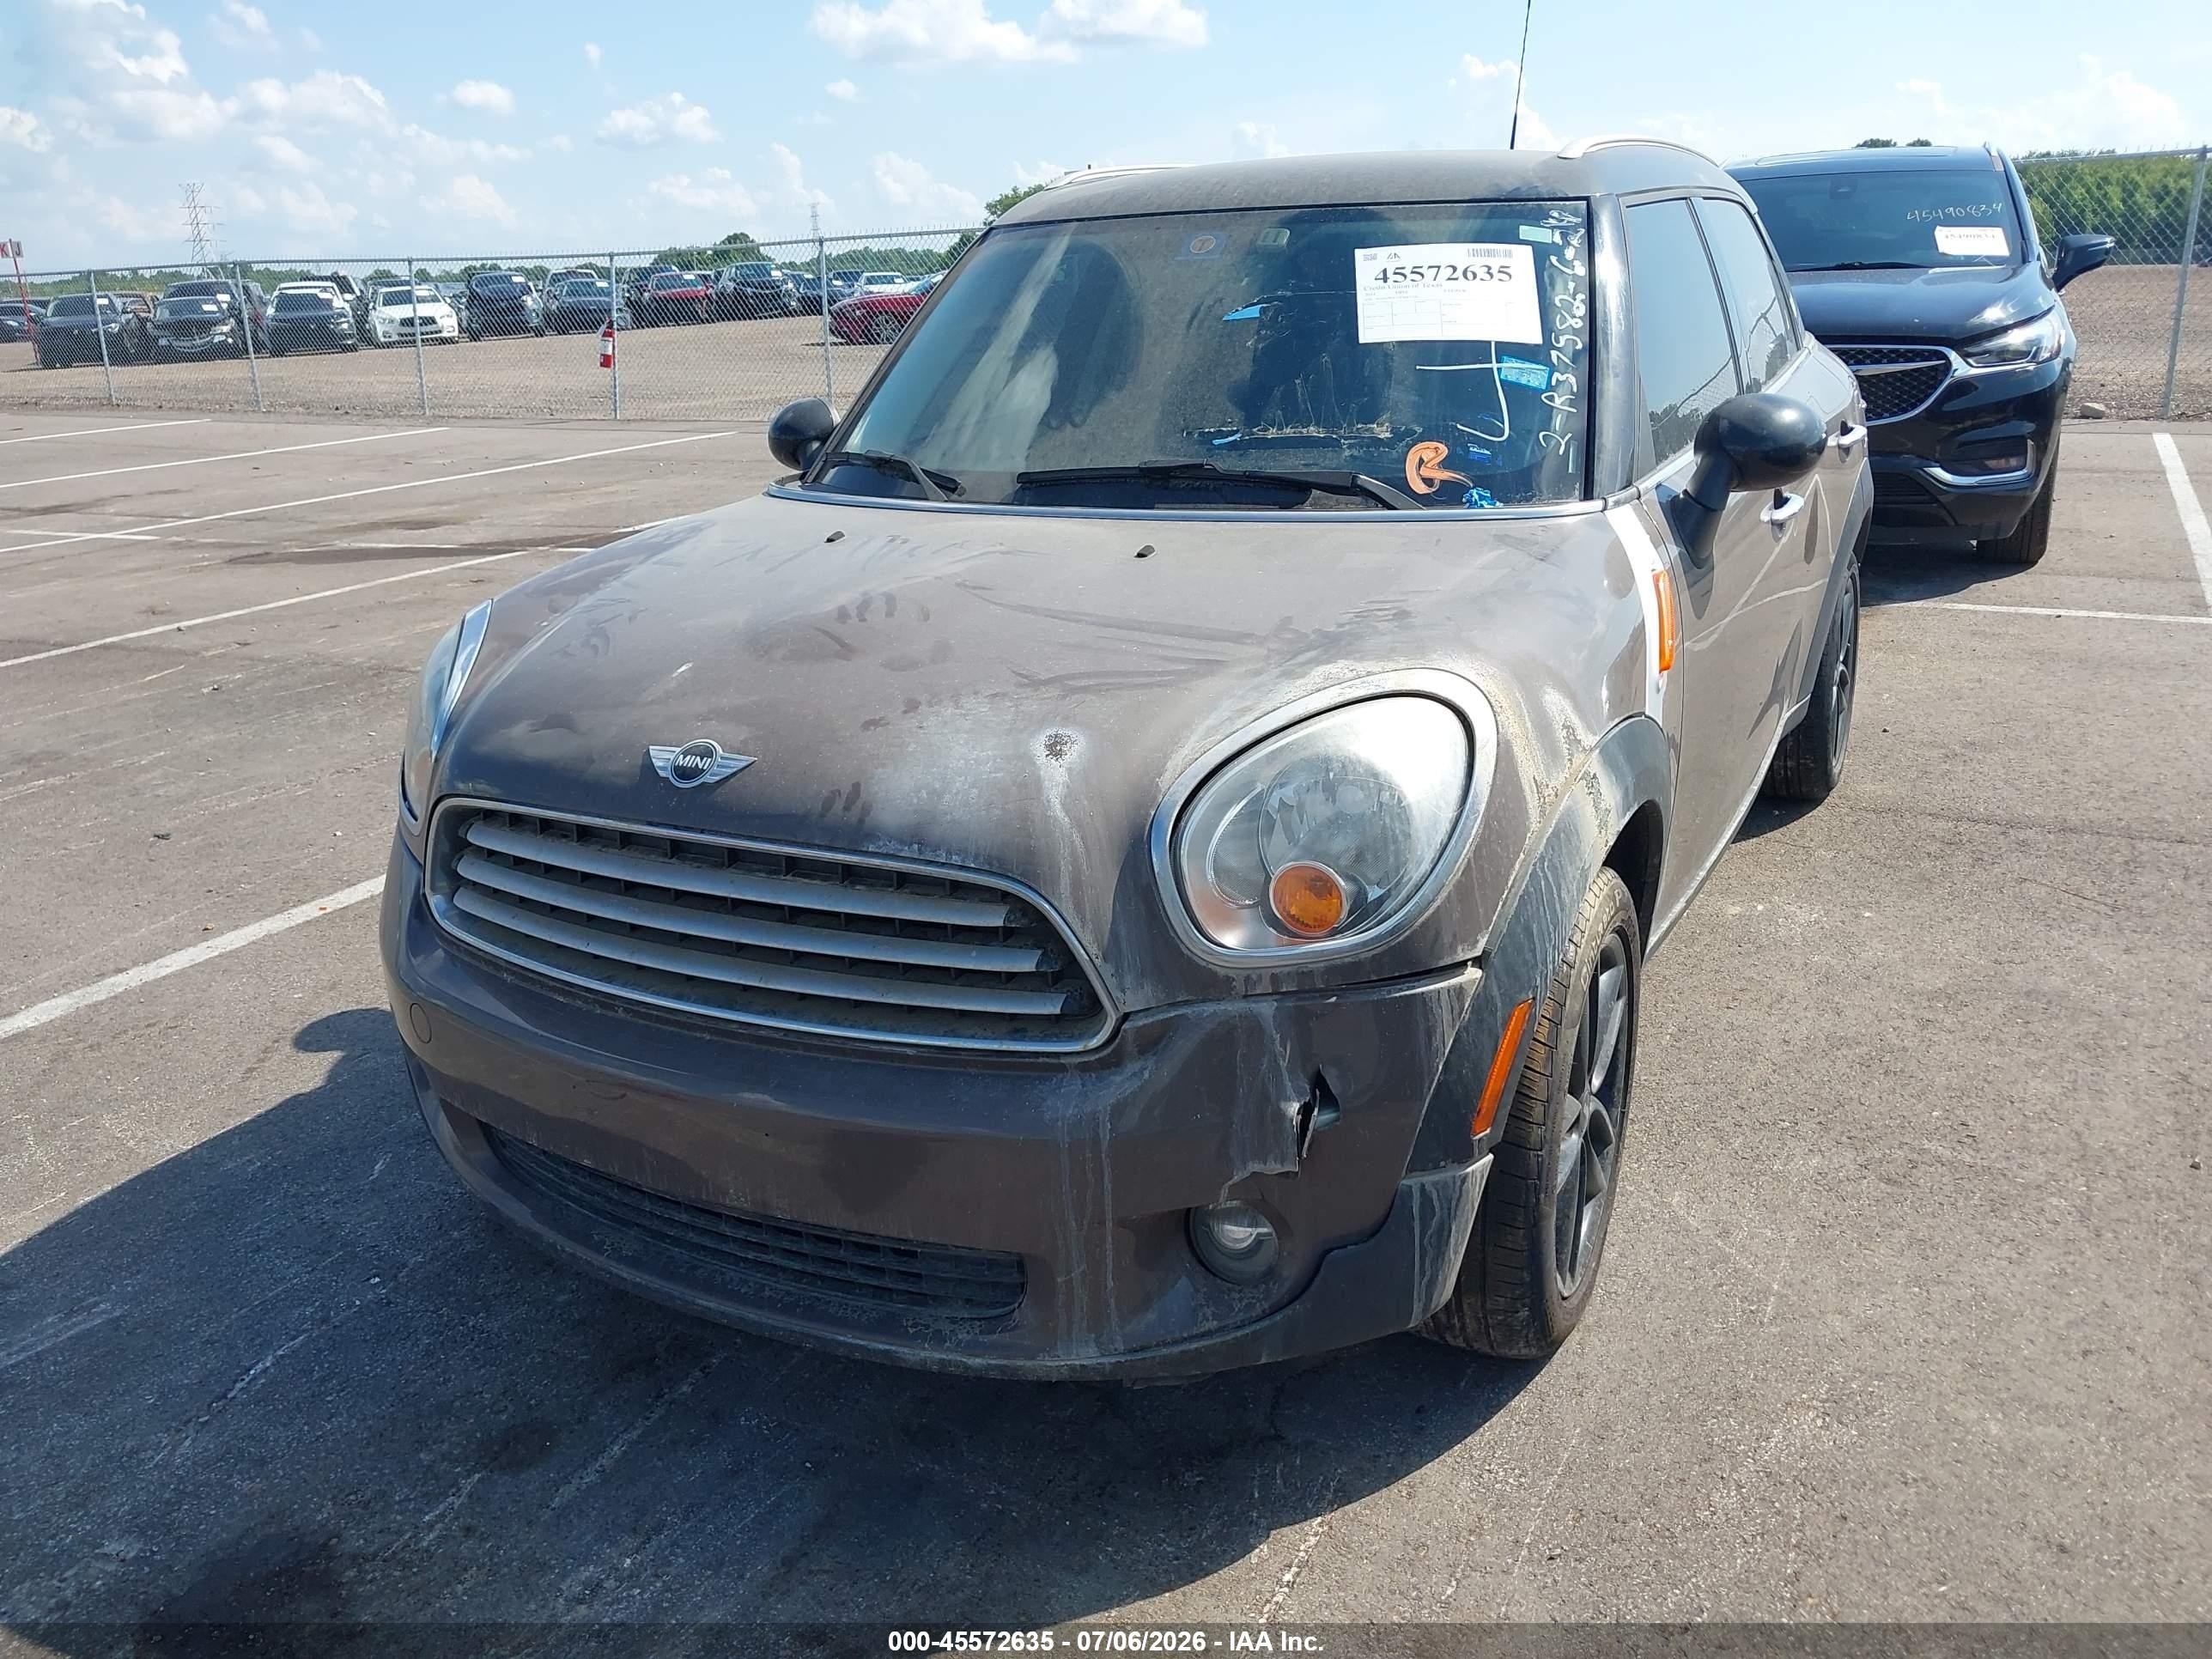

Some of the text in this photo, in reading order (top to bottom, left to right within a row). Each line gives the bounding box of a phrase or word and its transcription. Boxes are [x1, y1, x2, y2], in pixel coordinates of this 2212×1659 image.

[1906, 202, 2003, 222] 45490834
[1374, 264, 1513, 283] 45572635
[675, 754, 712, 770] MINI
